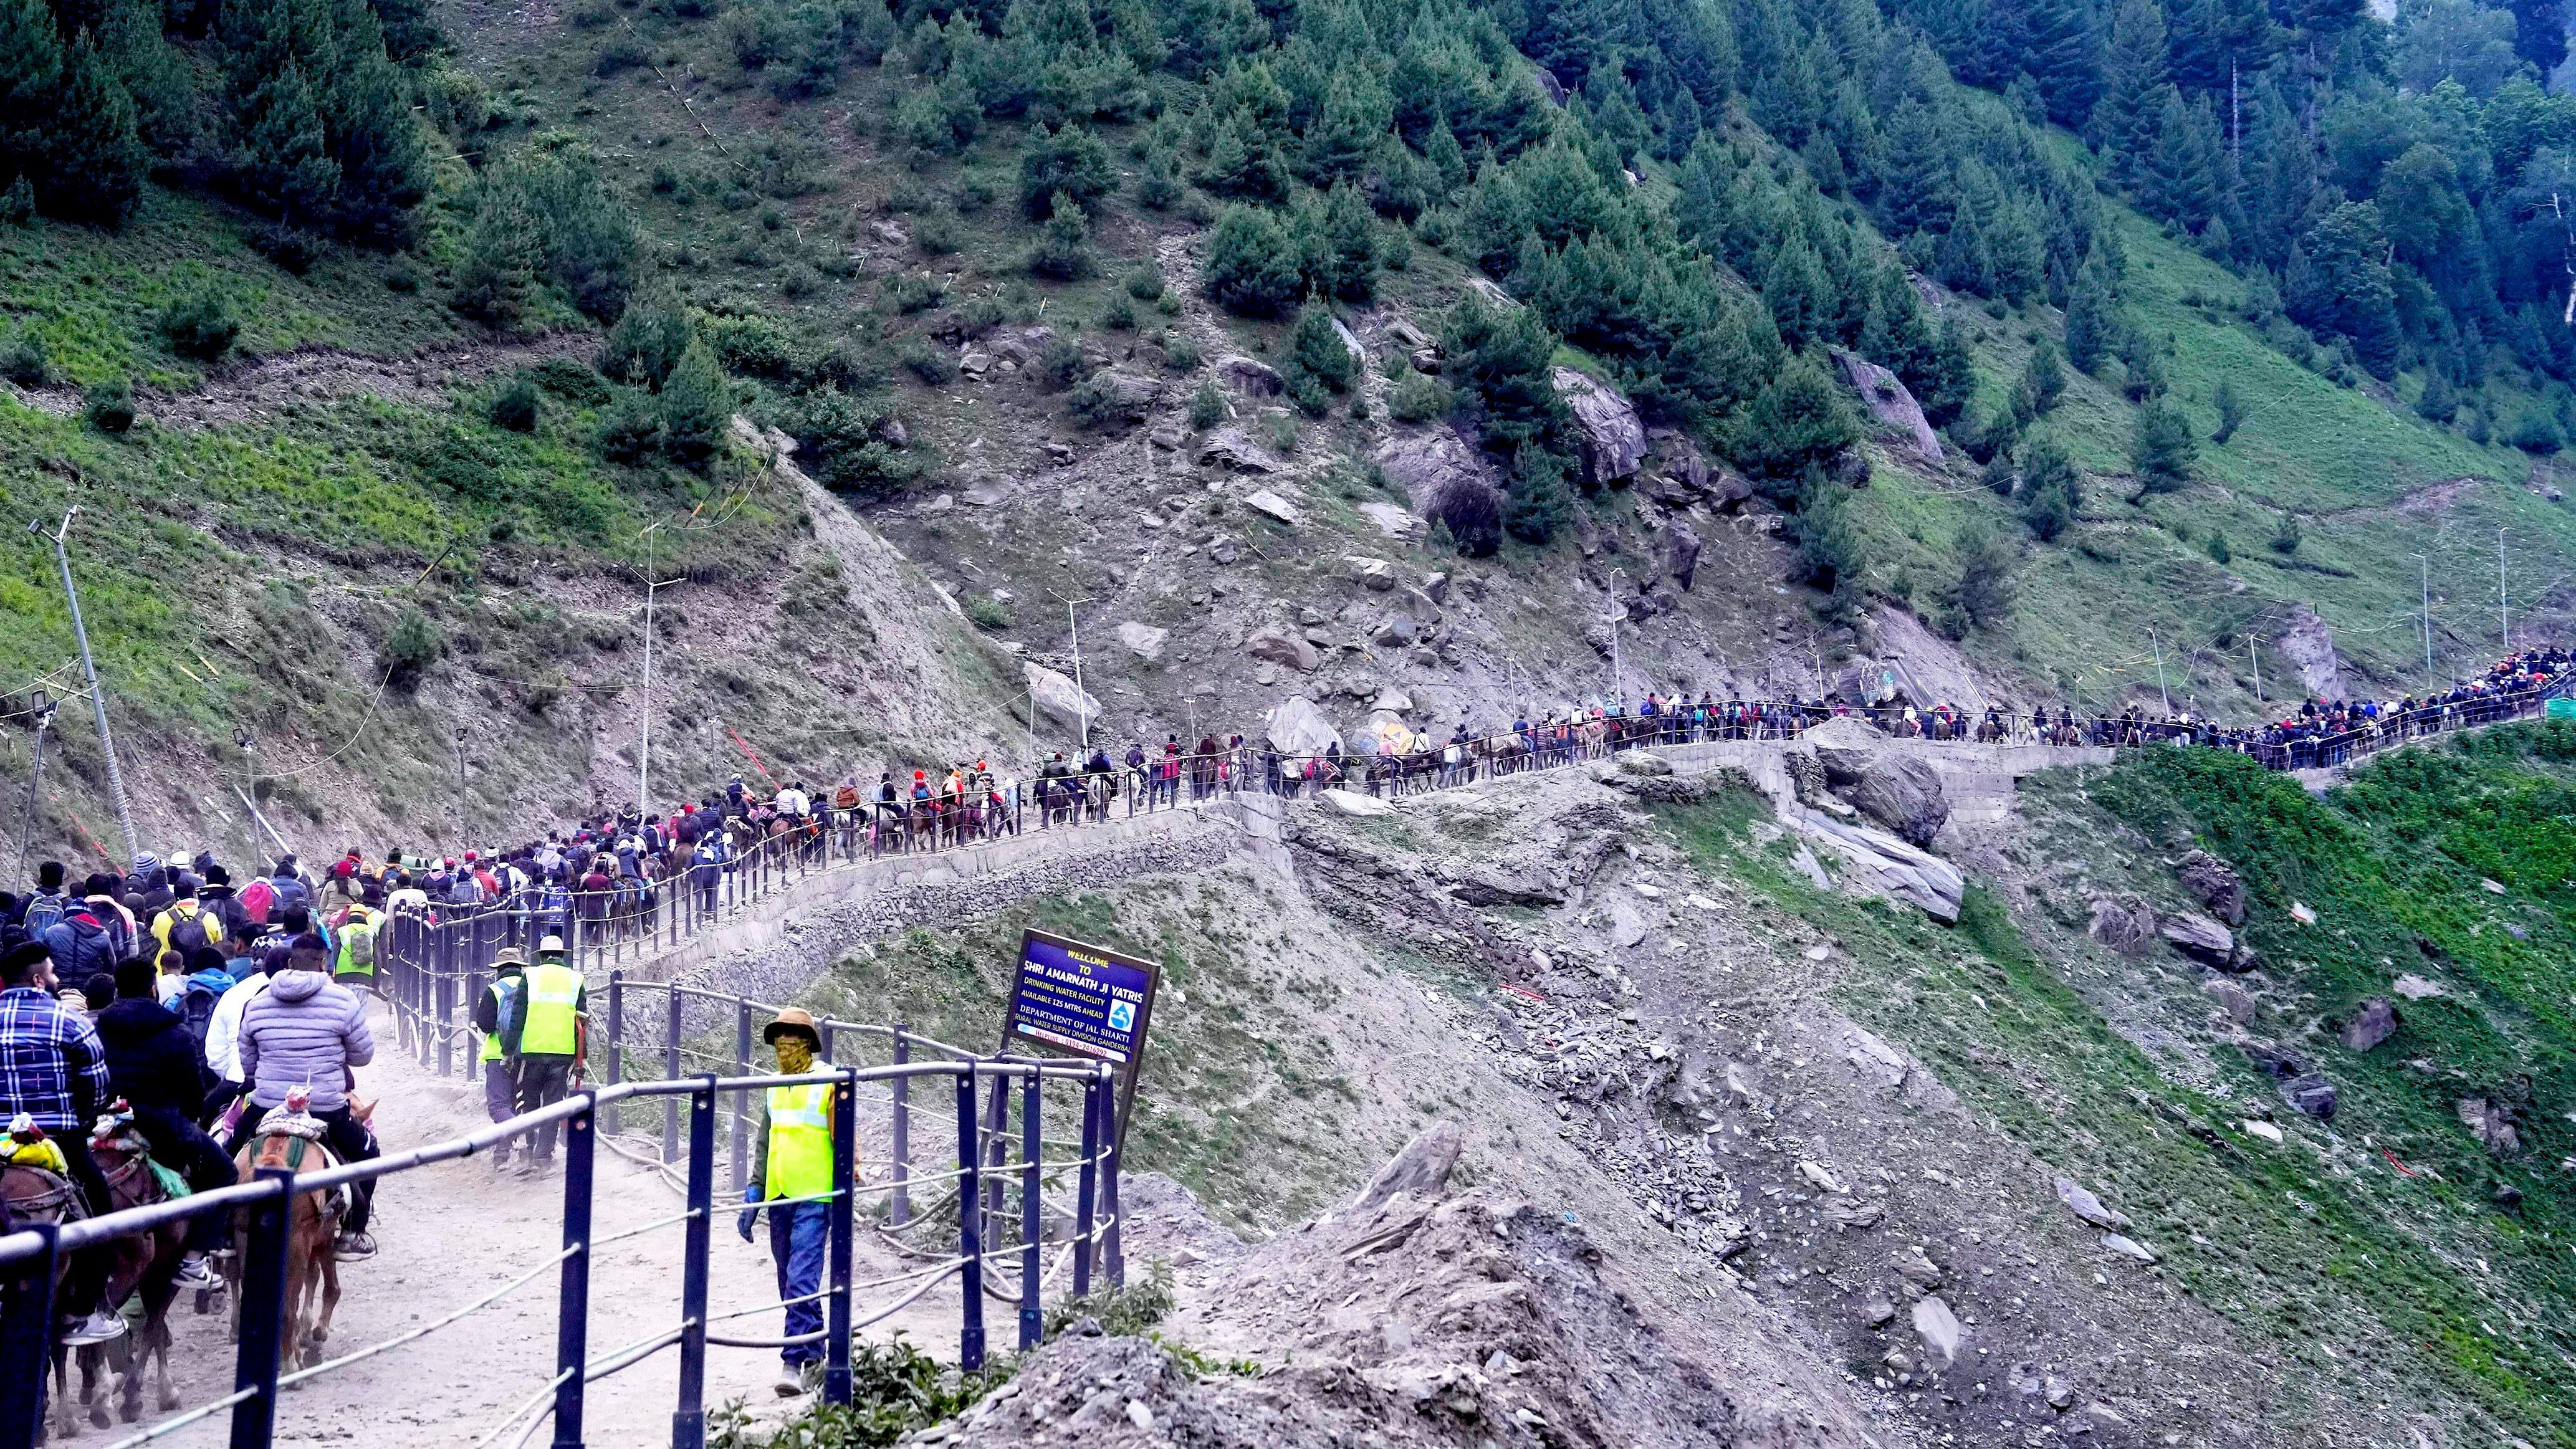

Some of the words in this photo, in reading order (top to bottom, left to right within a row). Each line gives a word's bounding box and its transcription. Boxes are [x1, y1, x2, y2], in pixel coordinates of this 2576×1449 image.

[1067, 950, 1109, 968] WELCOME
[1079, 964, 1091, 975] TO
[1024, 960, 1045, 975] SHRI
[1046, 967, 1098, 990] AMARNATH
[1099, 983, 1109, 993] JI
[1112, 985, 1143, 1003] YATRIS
[1024, 977, 1055, 992] DRINKING
[1056, 986, 1077, 998] WATER
[1078, 993, 1105, 1006] FACILITY
[1021, 990, 1051, 1004] AVAILABLE
[1053, 998, 1063, 1008] 125
[1064, 1002, 1081, 1013] MTRS
[1082, 1008, 1103, 1019] AHEAD
[1015, 1013, 1032, 1023] RURAL
[1033, 1018, 1051, 1029] WATER
[1051, 1024, 1071, 1035] SUPPLY
[1072, 1030, 1096, 1043] DIVISION
[1098, 1038, 1131, 1053] GANDERBAL
[1020, 1004, 1073, 1026] DEPARTMENT
[1073, 1020, 1085, 1030] OF
[1085, 1024, 1099, 1034] JAL
[1100, 1028, 1129, 1043] SHAKTI
